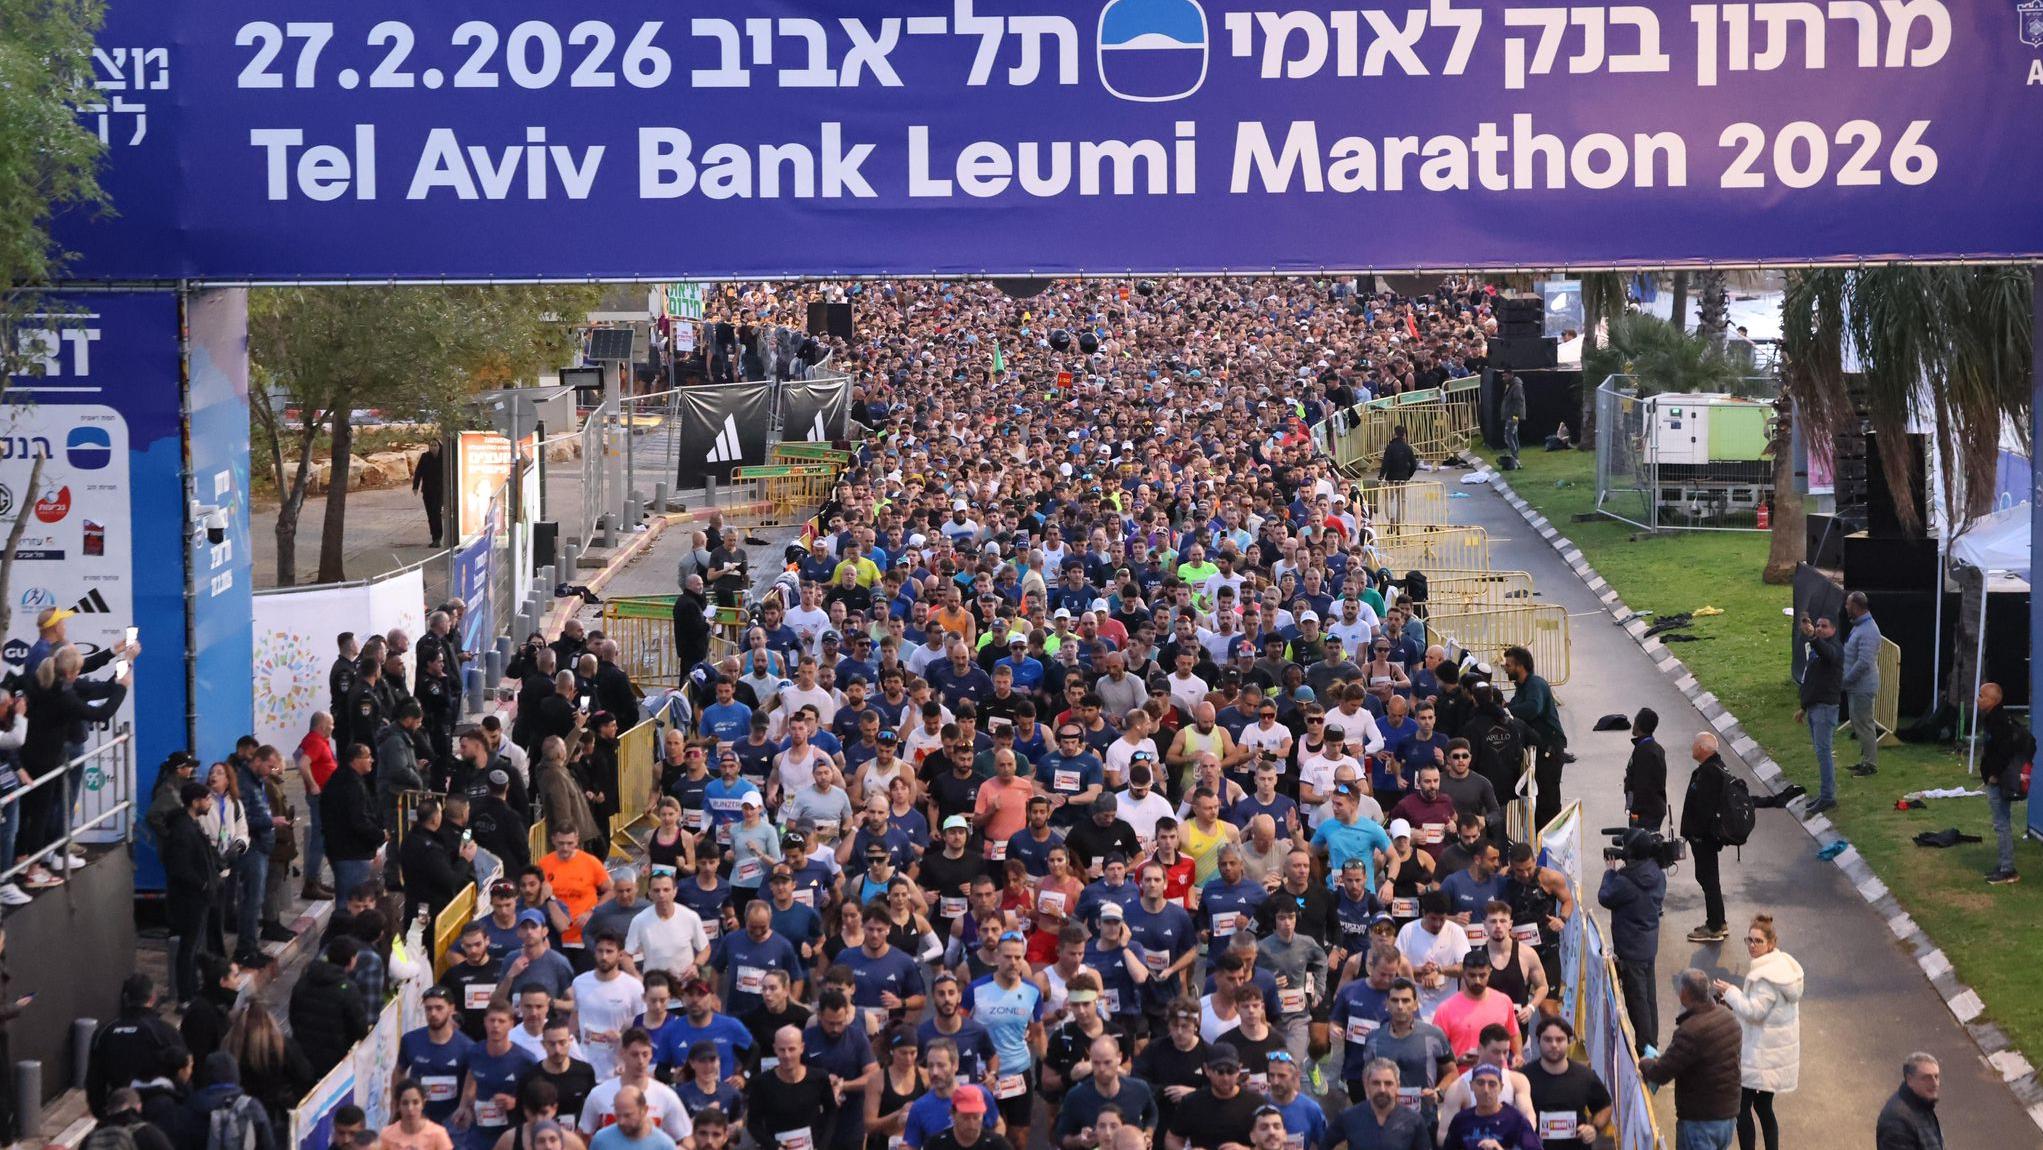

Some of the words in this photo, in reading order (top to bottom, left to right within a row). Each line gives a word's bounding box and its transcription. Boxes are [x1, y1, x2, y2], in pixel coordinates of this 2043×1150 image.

[75, 47, 169, 90] מוצ
[236, 20, 673, 89] 27.2.2026
[1225, 0, 1482, 80] לאומי
[1504, 5, 1671, 90] בנק
[1690, 0, 1953, 87] מרתון
[250, 123, 376, 201] Tel
[406, 126, 606, 200] Aviv
[638, 121, 878, 200] Bank
[908, 120, 1196, 198] Leumi
[1229, 112, 1690, 195] Marathon
[1714, 118, 1939, 190] 2026
[8, 328, 101, 376] RT
[4, 647, 29, 658] GU
